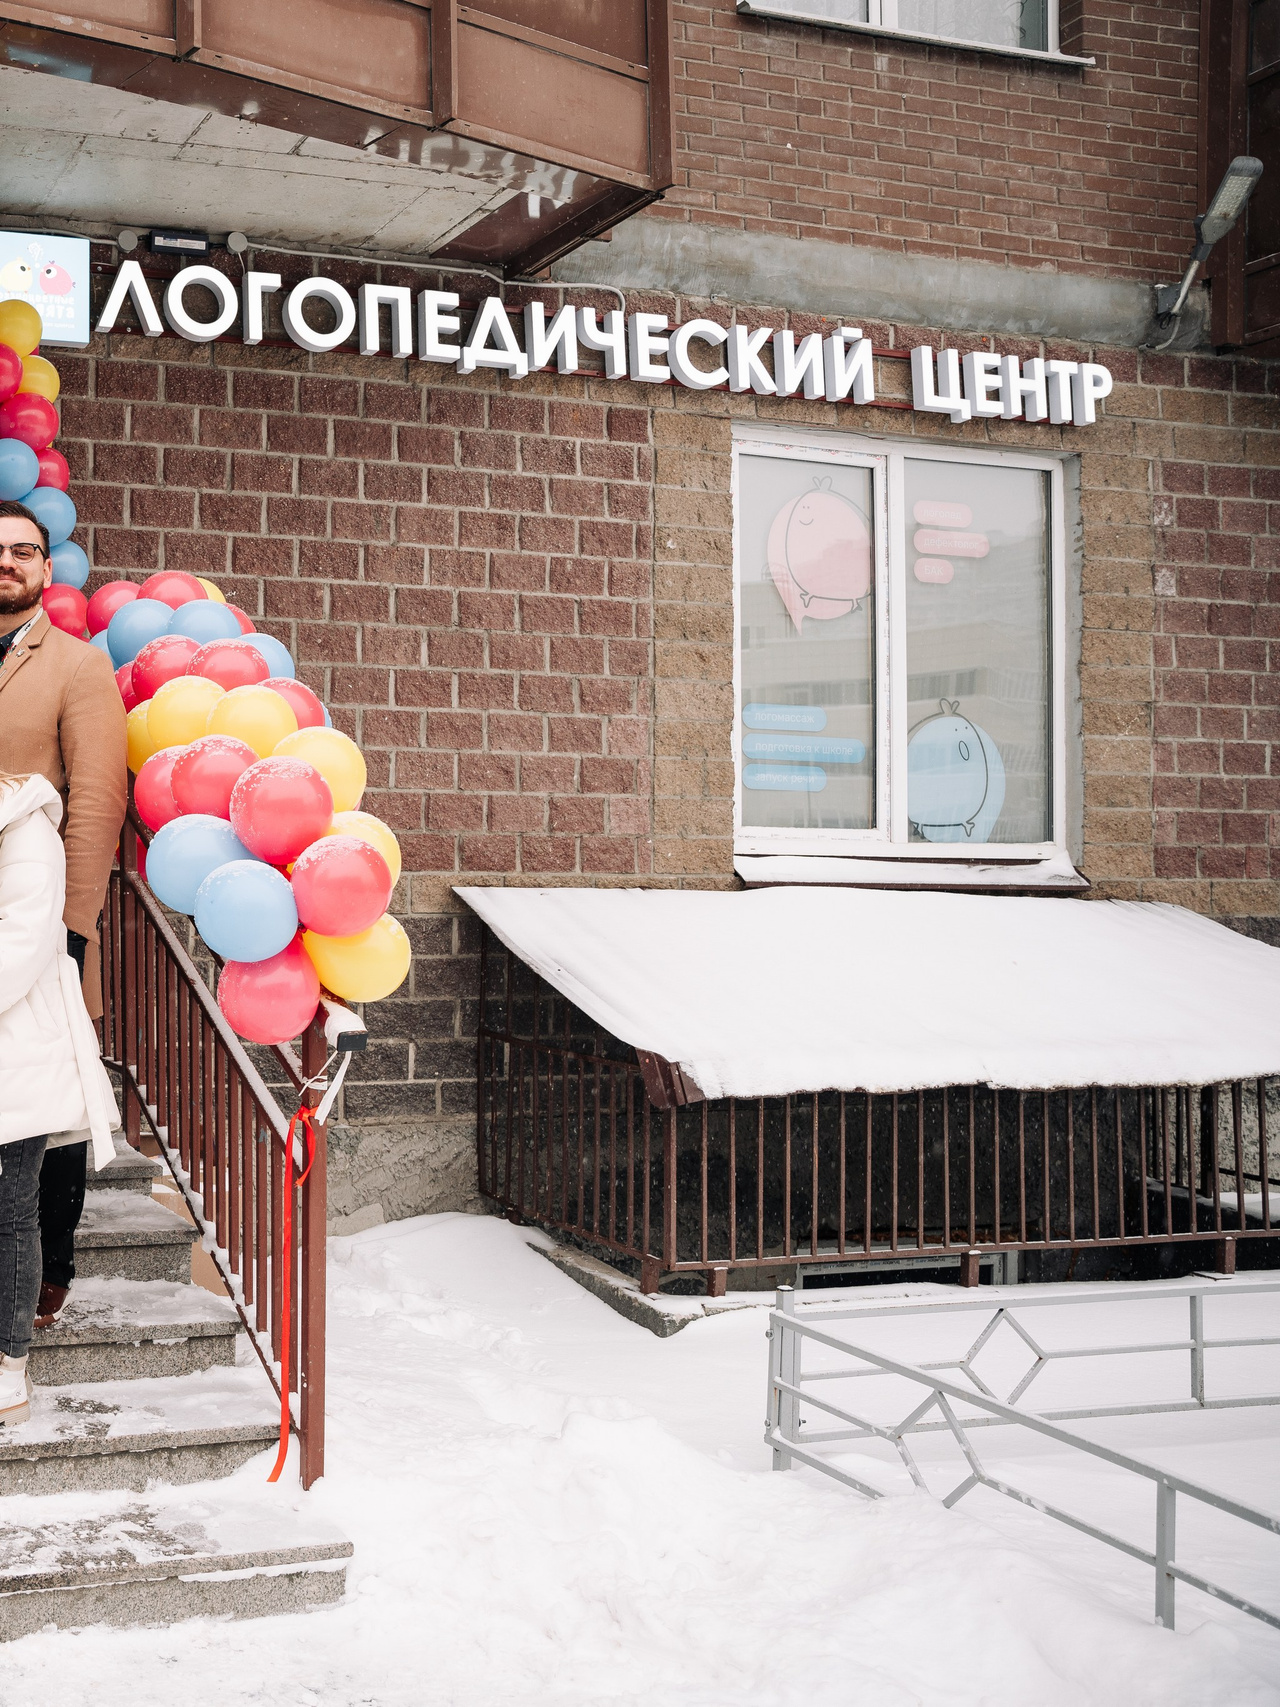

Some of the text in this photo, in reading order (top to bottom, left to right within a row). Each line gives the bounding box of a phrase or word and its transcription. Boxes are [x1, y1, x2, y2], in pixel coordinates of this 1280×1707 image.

[96, 260, 1112, 424] ЛОГОПЕДИЧЕСКИЙ ЦЕНТР
[923, 509, 962, 521] логопед
[923, 537, 979, 549] дефектолог
[924, 564, 944, 576] БАК
[754, 711, 815, 723] логомассаж
[755, 742, 812, 753] подготовка
[822, 746, 854, 756] школе
[754, 773, 815, 785] запуск речи
